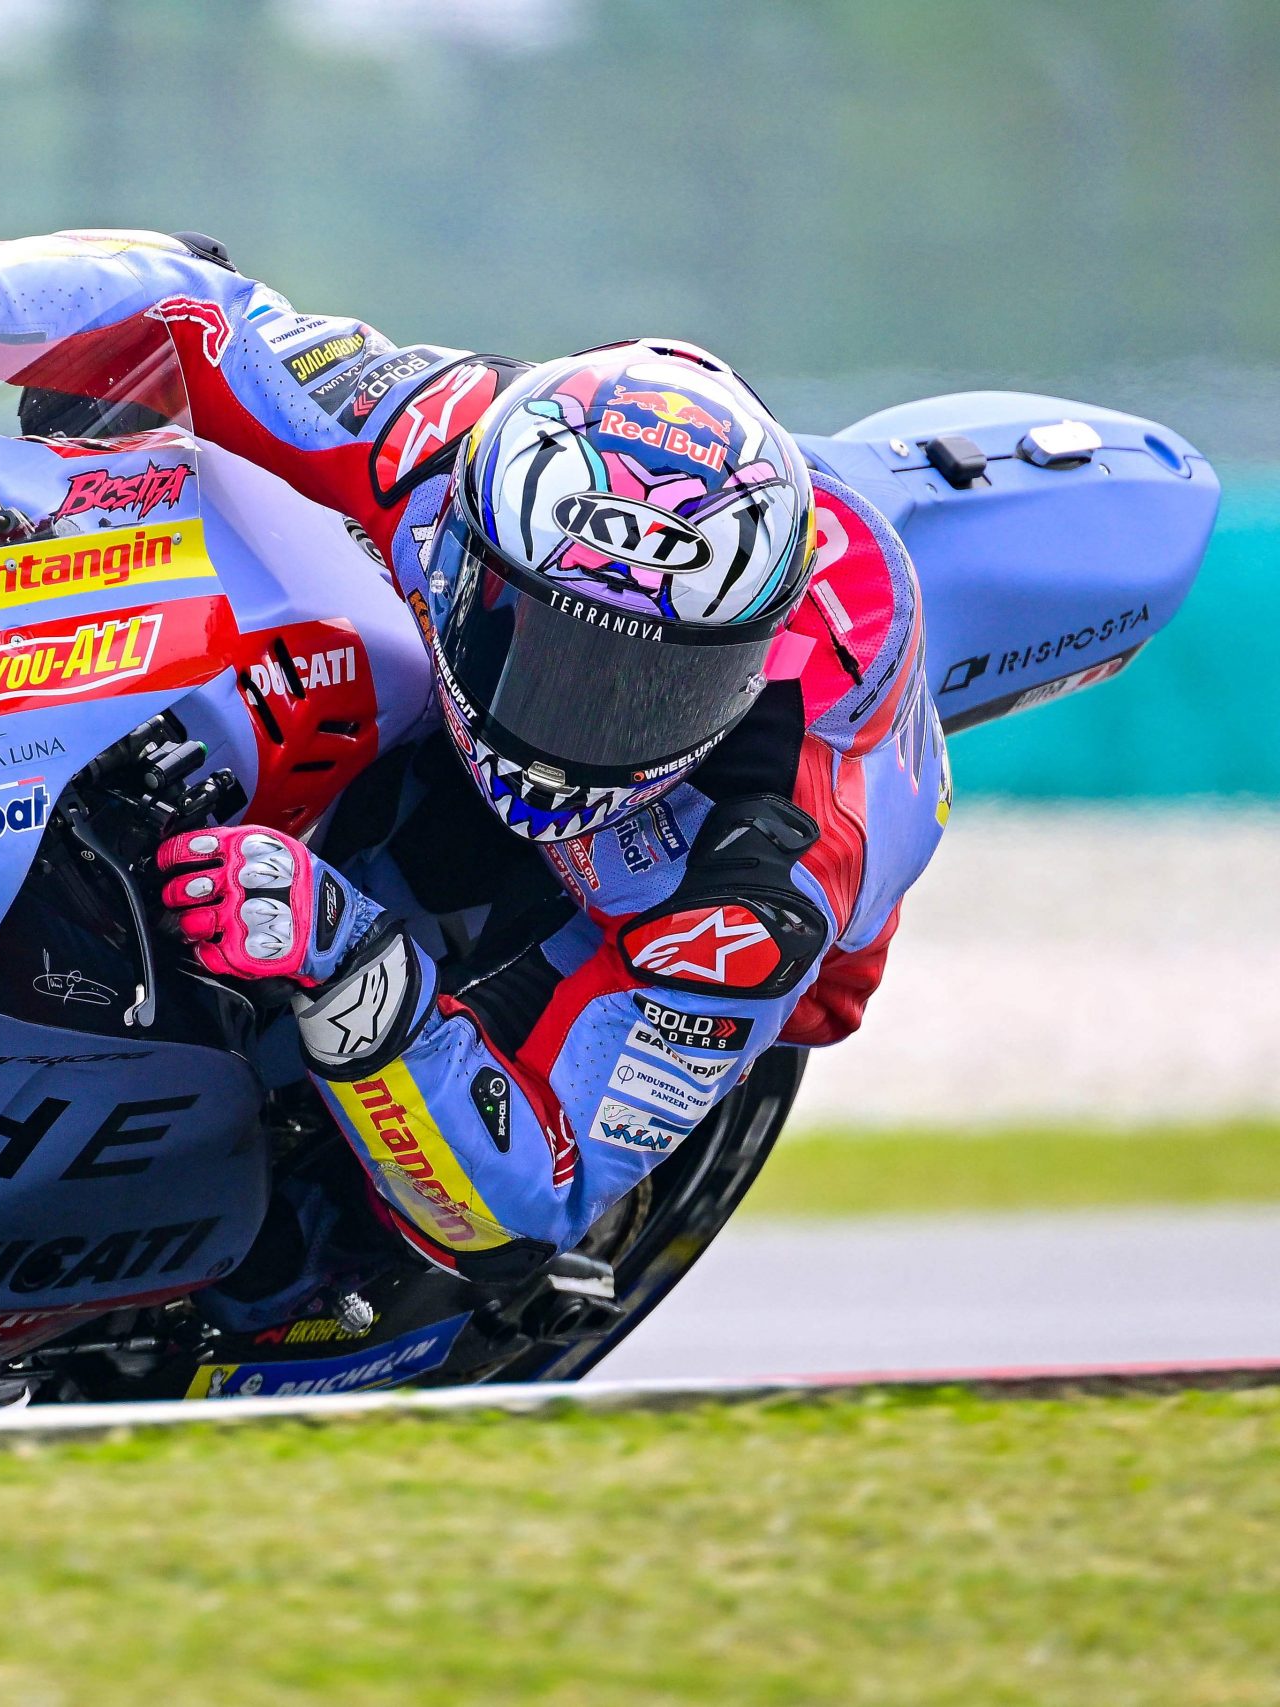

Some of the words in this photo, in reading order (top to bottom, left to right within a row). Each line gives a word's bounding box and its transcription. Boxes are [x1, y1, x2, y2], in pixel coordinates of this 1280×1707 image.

[315, 375, 345, 395] LUNA
[368, 358, 431, 398] BOLD
[600, 411, 666, 448] Red
[665, 429, 727, 472] Bull
[566, 500, 704, 562] KYT
[550, 590, 664, 642] TERRANOVA
[246, 646, 356, 706] DUCATI
[432, 635, 478, 720] WHEELUP.IT
[10, 736, 66, 766] LUNA
[644, 730, 726, 780] WHEELUP.IT
[616, 820, 655, 875] ibat
[652, 803, 680, 850] ICHELIN
[585, 867, 596, 885] OIL
[644, 1002, 713, 1036] BOLD
[637, 1072, 685, 1098] INDUSTRIA
[651, 1089, 689, 1110] PANZERI
